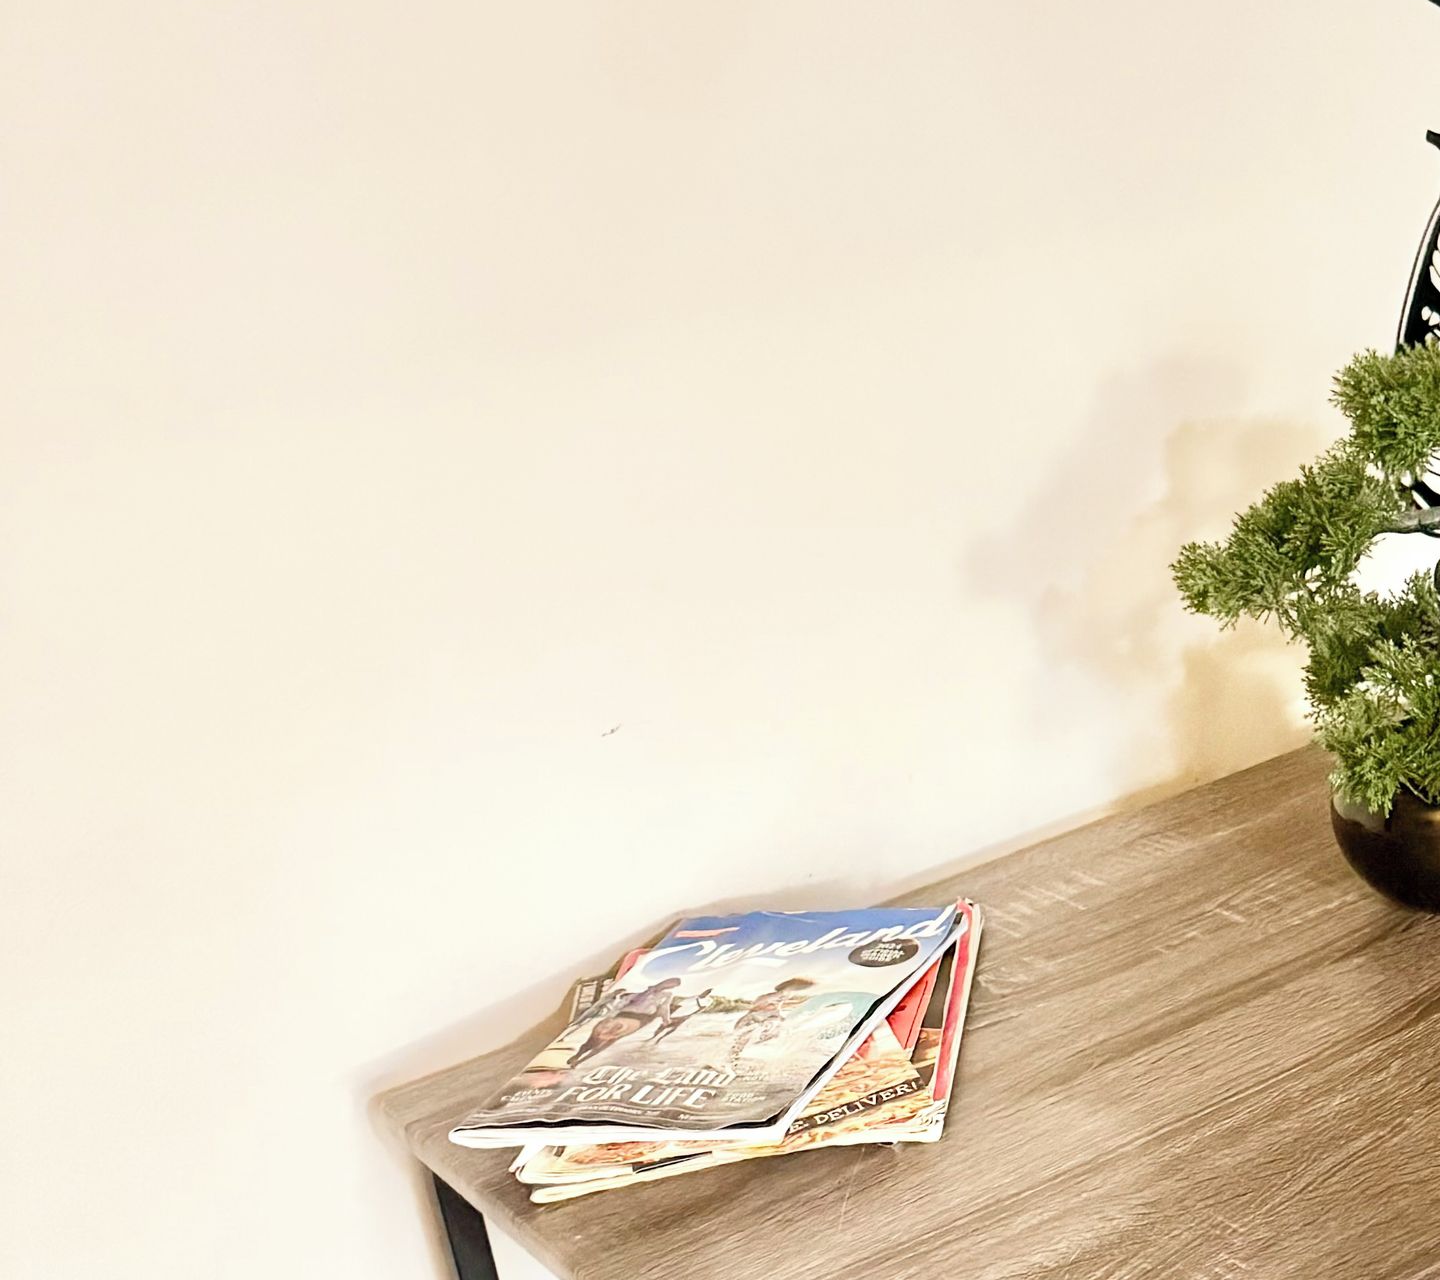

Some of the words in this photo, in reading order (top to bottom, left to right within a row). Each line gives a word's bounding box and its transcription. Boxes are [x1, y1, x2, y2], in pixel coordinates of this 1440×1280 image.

[637, 905, 957, 972] Cleveland
[582, 1065, 644, 1085] The
[650, 1064, 738, 1088] Land
[554, 1083, 633, 1103] FOR
[629, 1085, 717, 1108] LIFE
[814, 1081, 918, 1124] DELIVER!
